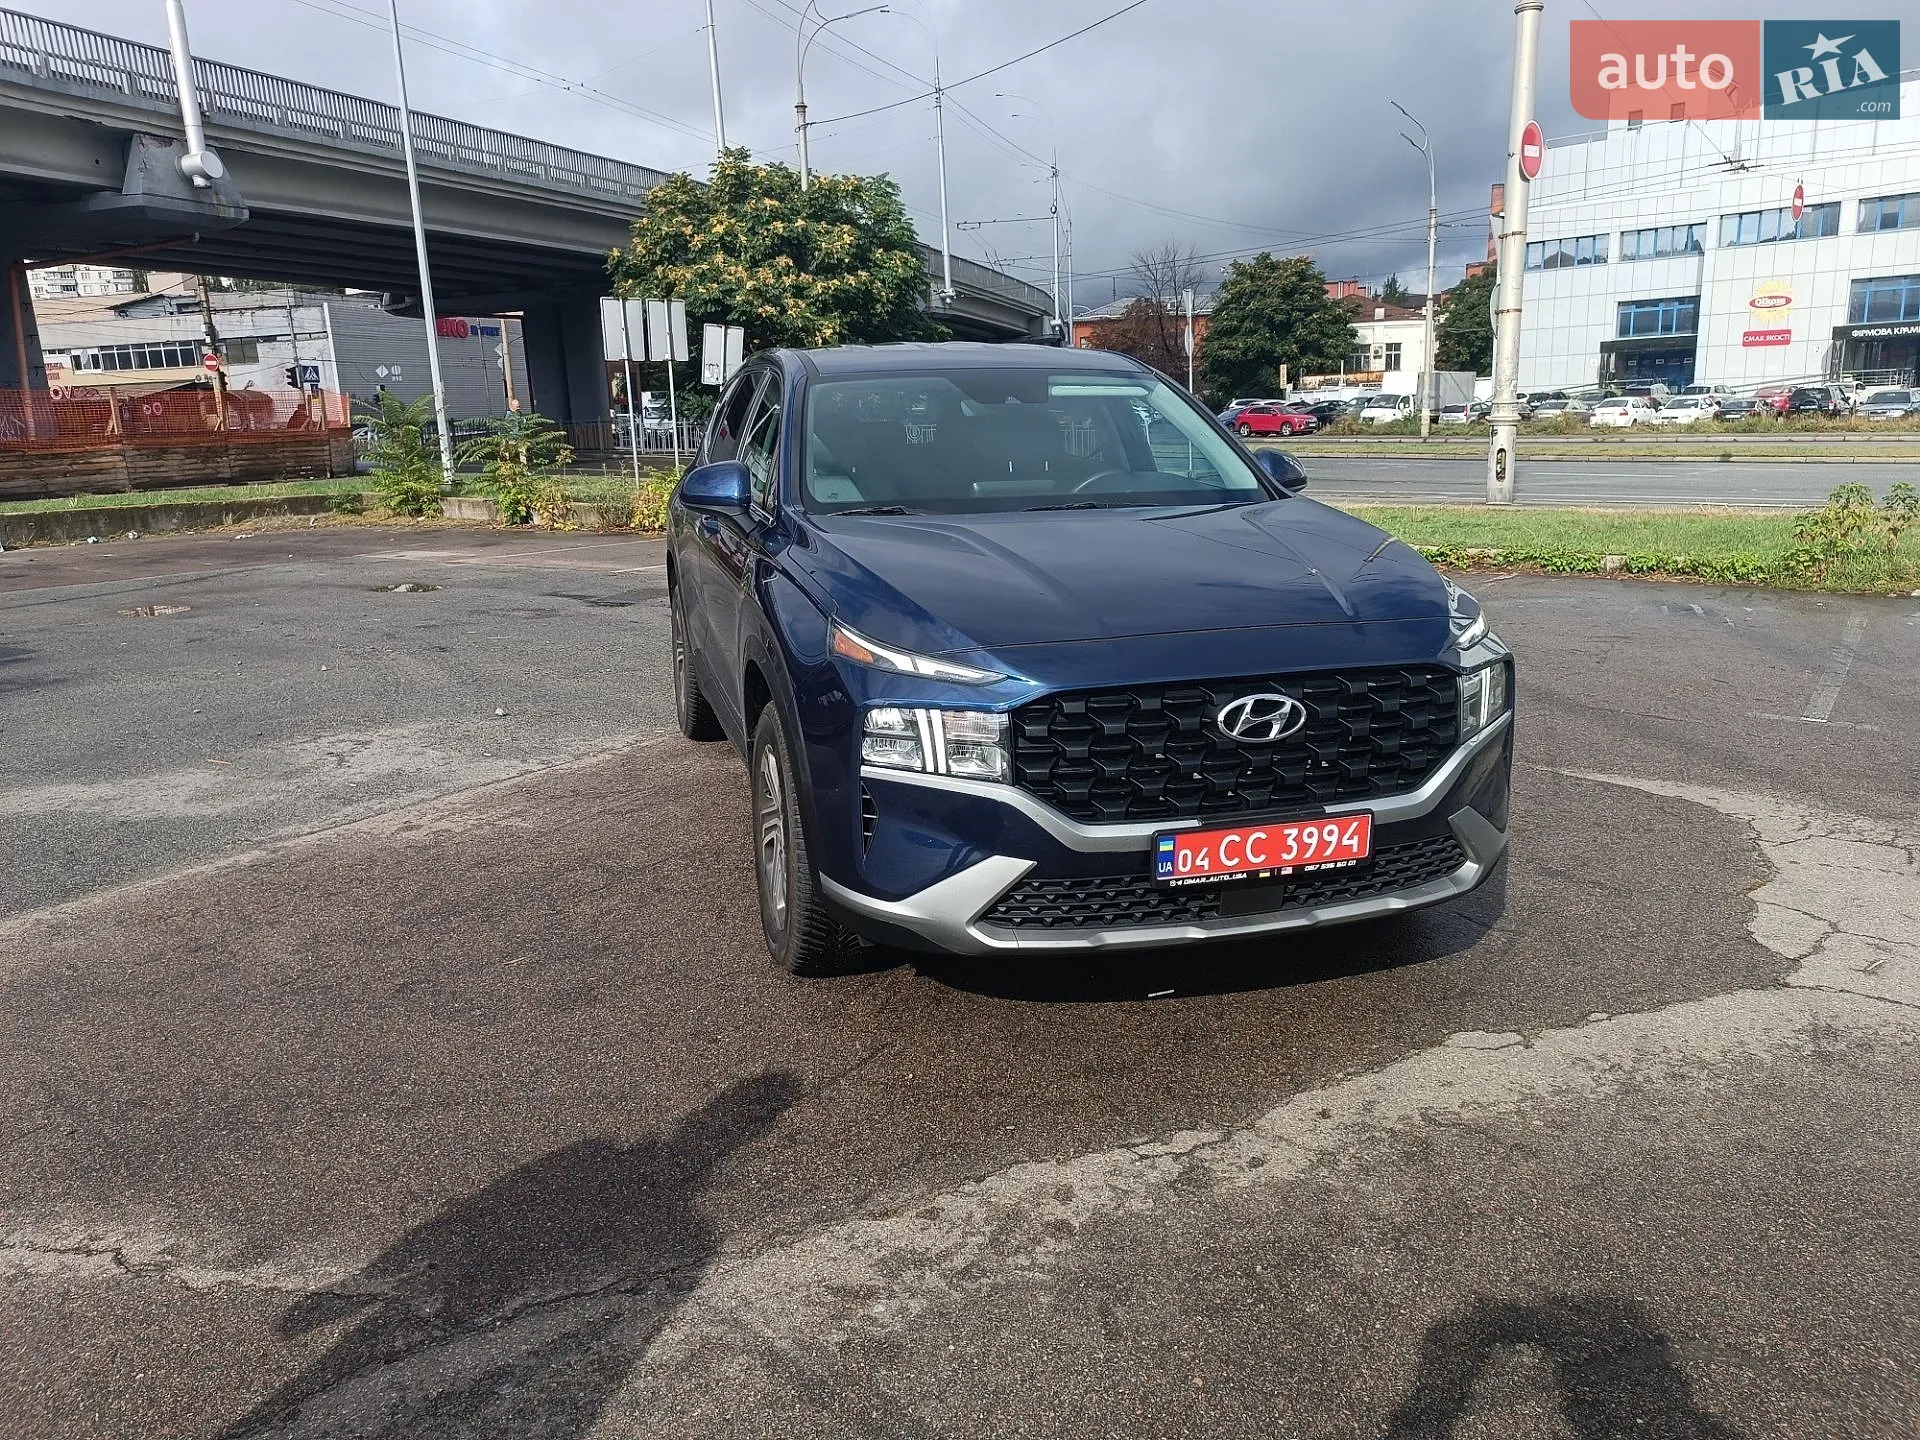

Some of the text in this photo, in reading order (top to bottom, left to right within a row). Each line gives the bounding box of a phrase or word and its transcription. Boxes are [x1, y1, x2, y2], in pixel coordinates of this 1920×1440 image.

[1851, 328, 1893, 337] ФІРМОВА
[1158, 821, 1360, 873] UA 04 CC 3994
